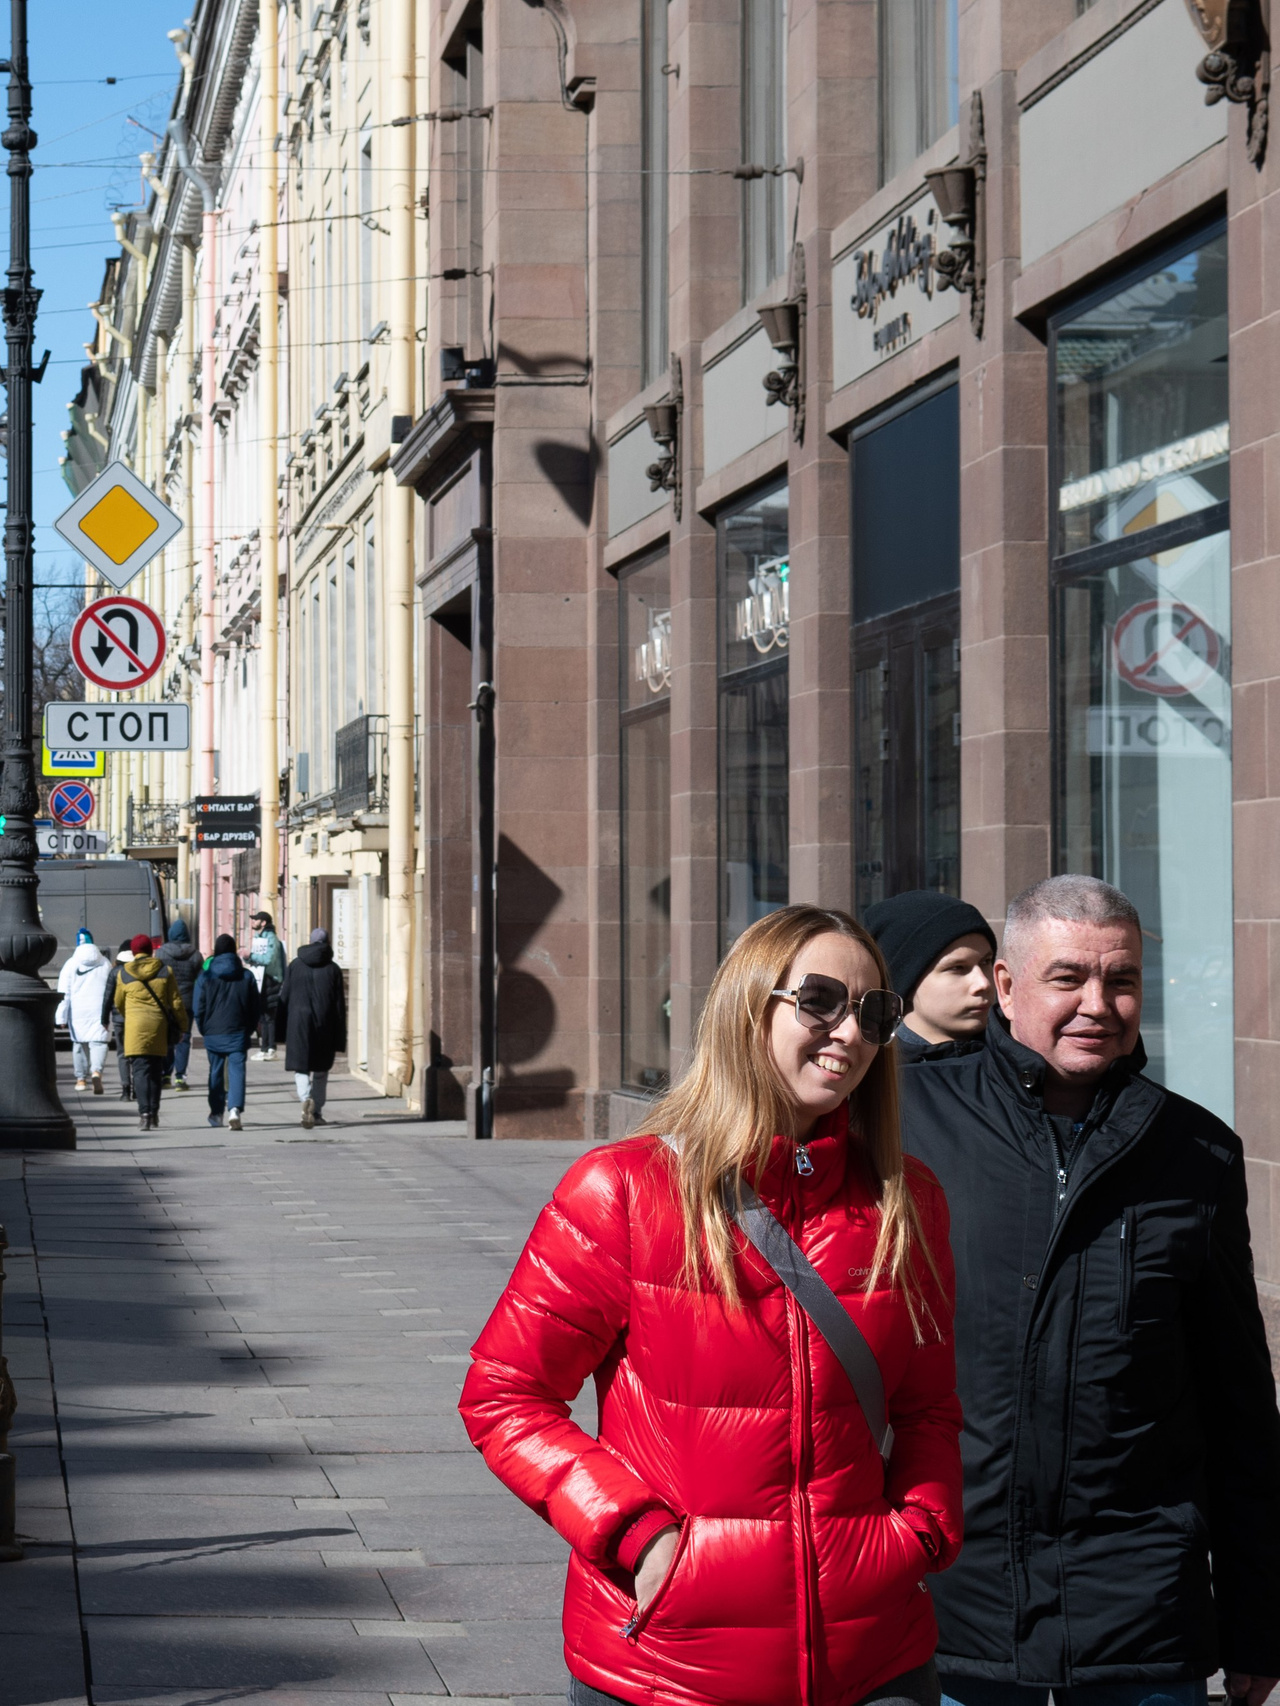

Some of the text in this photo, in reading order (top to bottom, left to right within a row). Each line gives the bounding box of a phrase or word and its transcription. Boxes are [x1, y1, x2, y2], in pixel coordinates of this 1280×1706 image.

[67, 711, 169, 742] СТОП
[196, 803, 255, 812] КОНТАКТ БАР
[47, 834, 97, 849] СТОП
[221, 831, 255, 841] ДРУЗЕЙ
